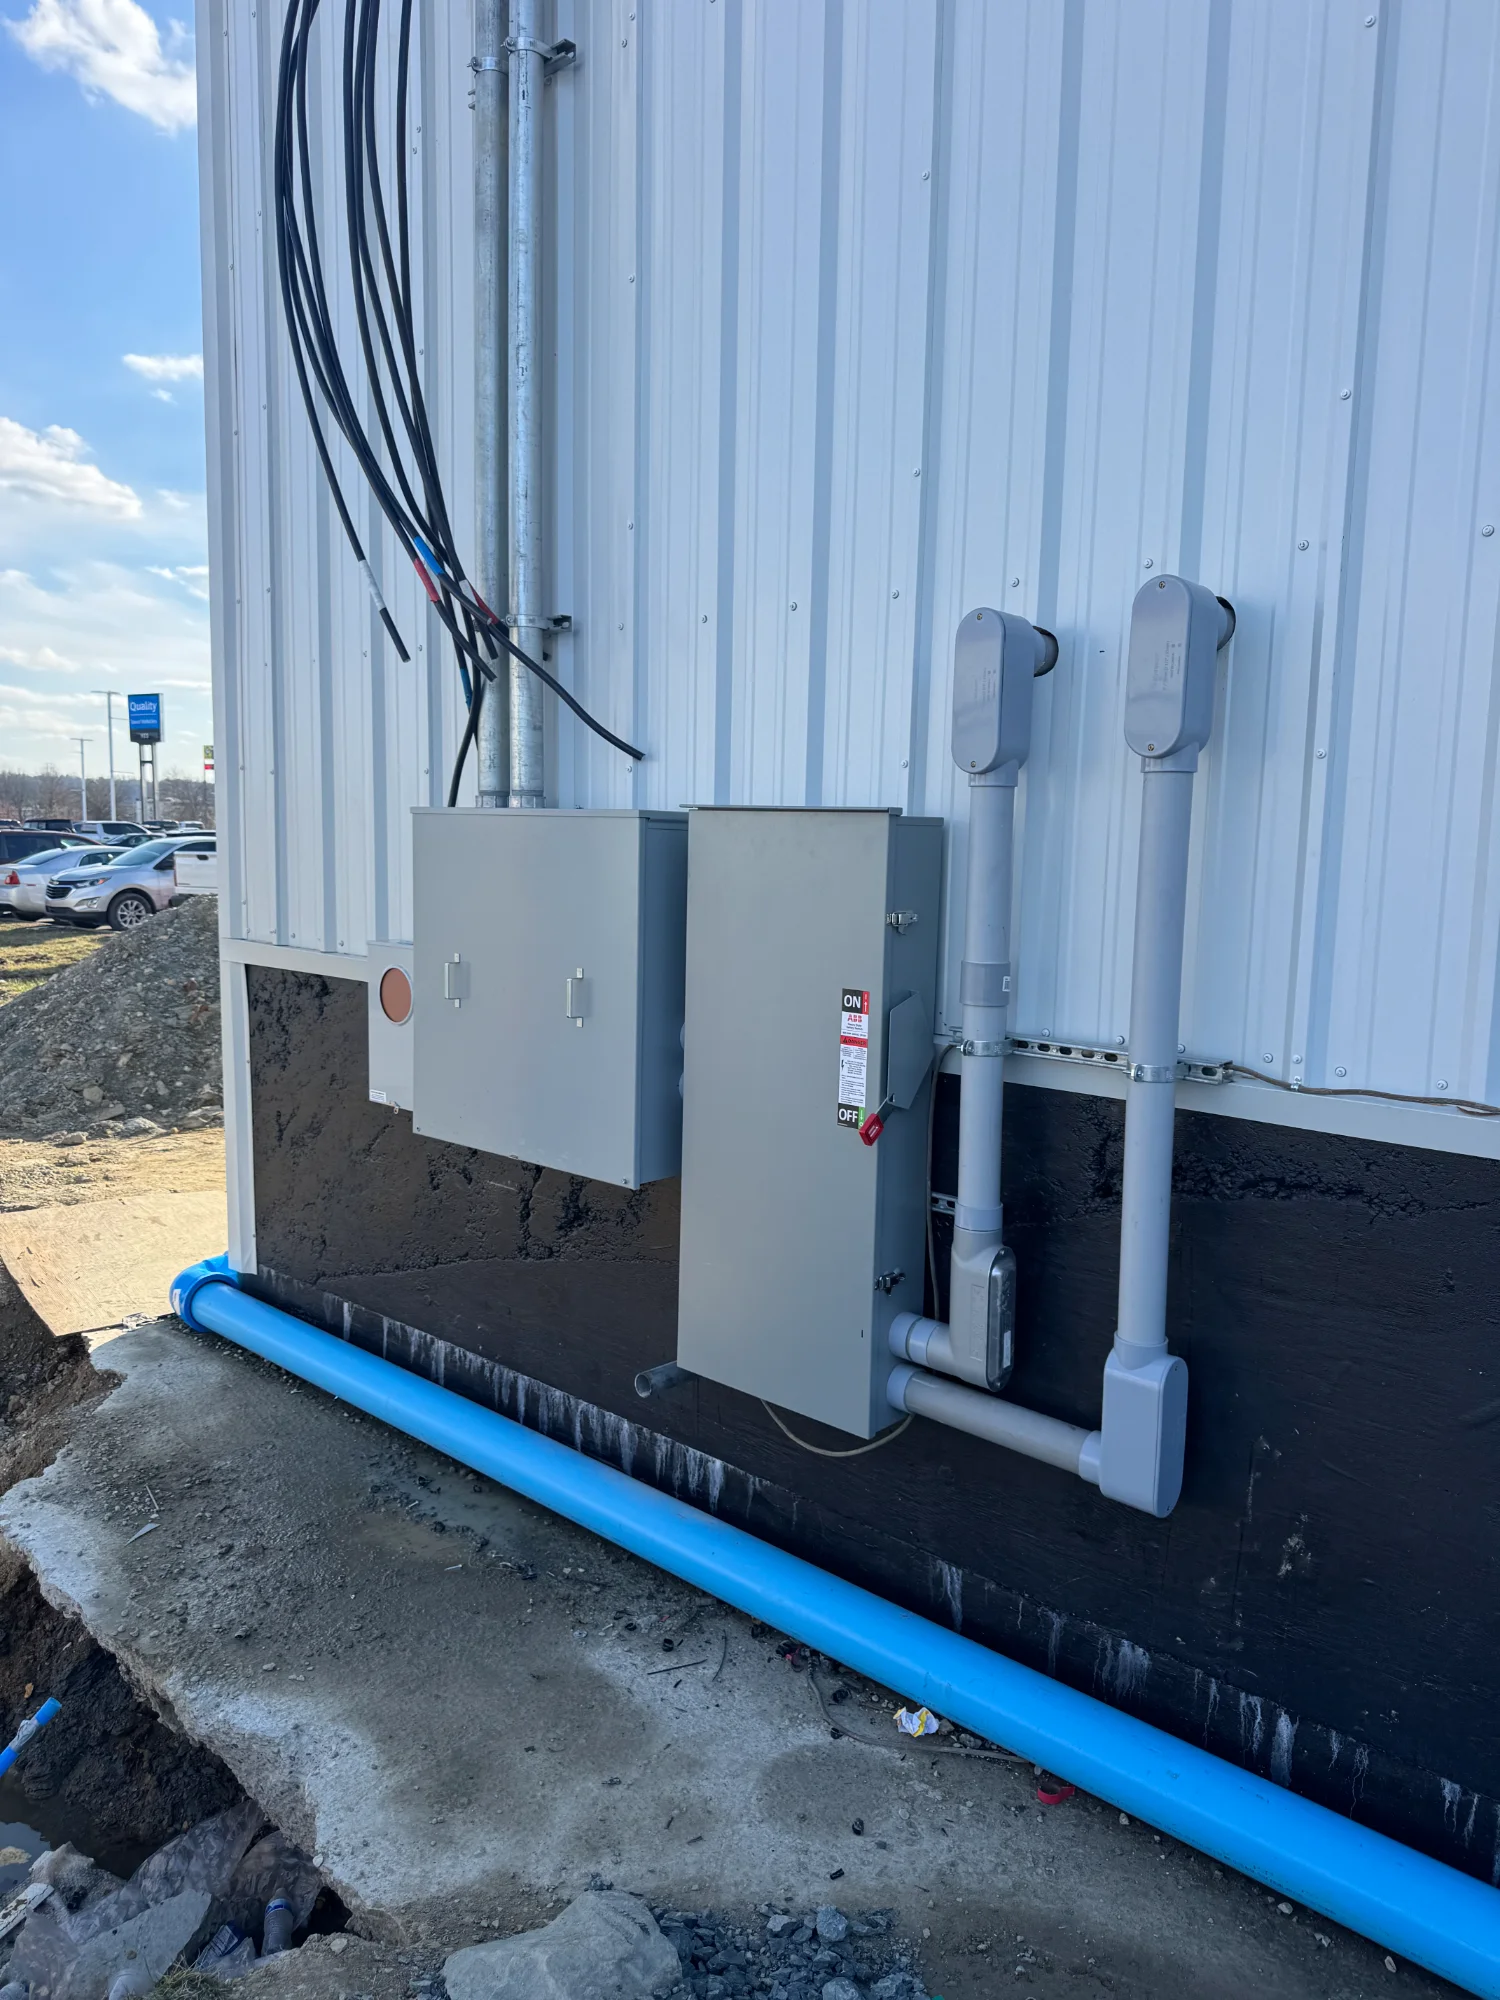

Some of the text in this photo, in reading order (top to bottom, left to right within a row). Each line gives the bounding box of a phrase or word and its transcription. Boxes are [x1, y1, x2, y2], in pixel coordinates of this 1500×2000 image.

[130, 701, 157, 712] Quality
[844, 995, 861, 1008] ON
[847, 1014, 862, 1023] ABB
[839, 1108, 858, 1122] OFF
